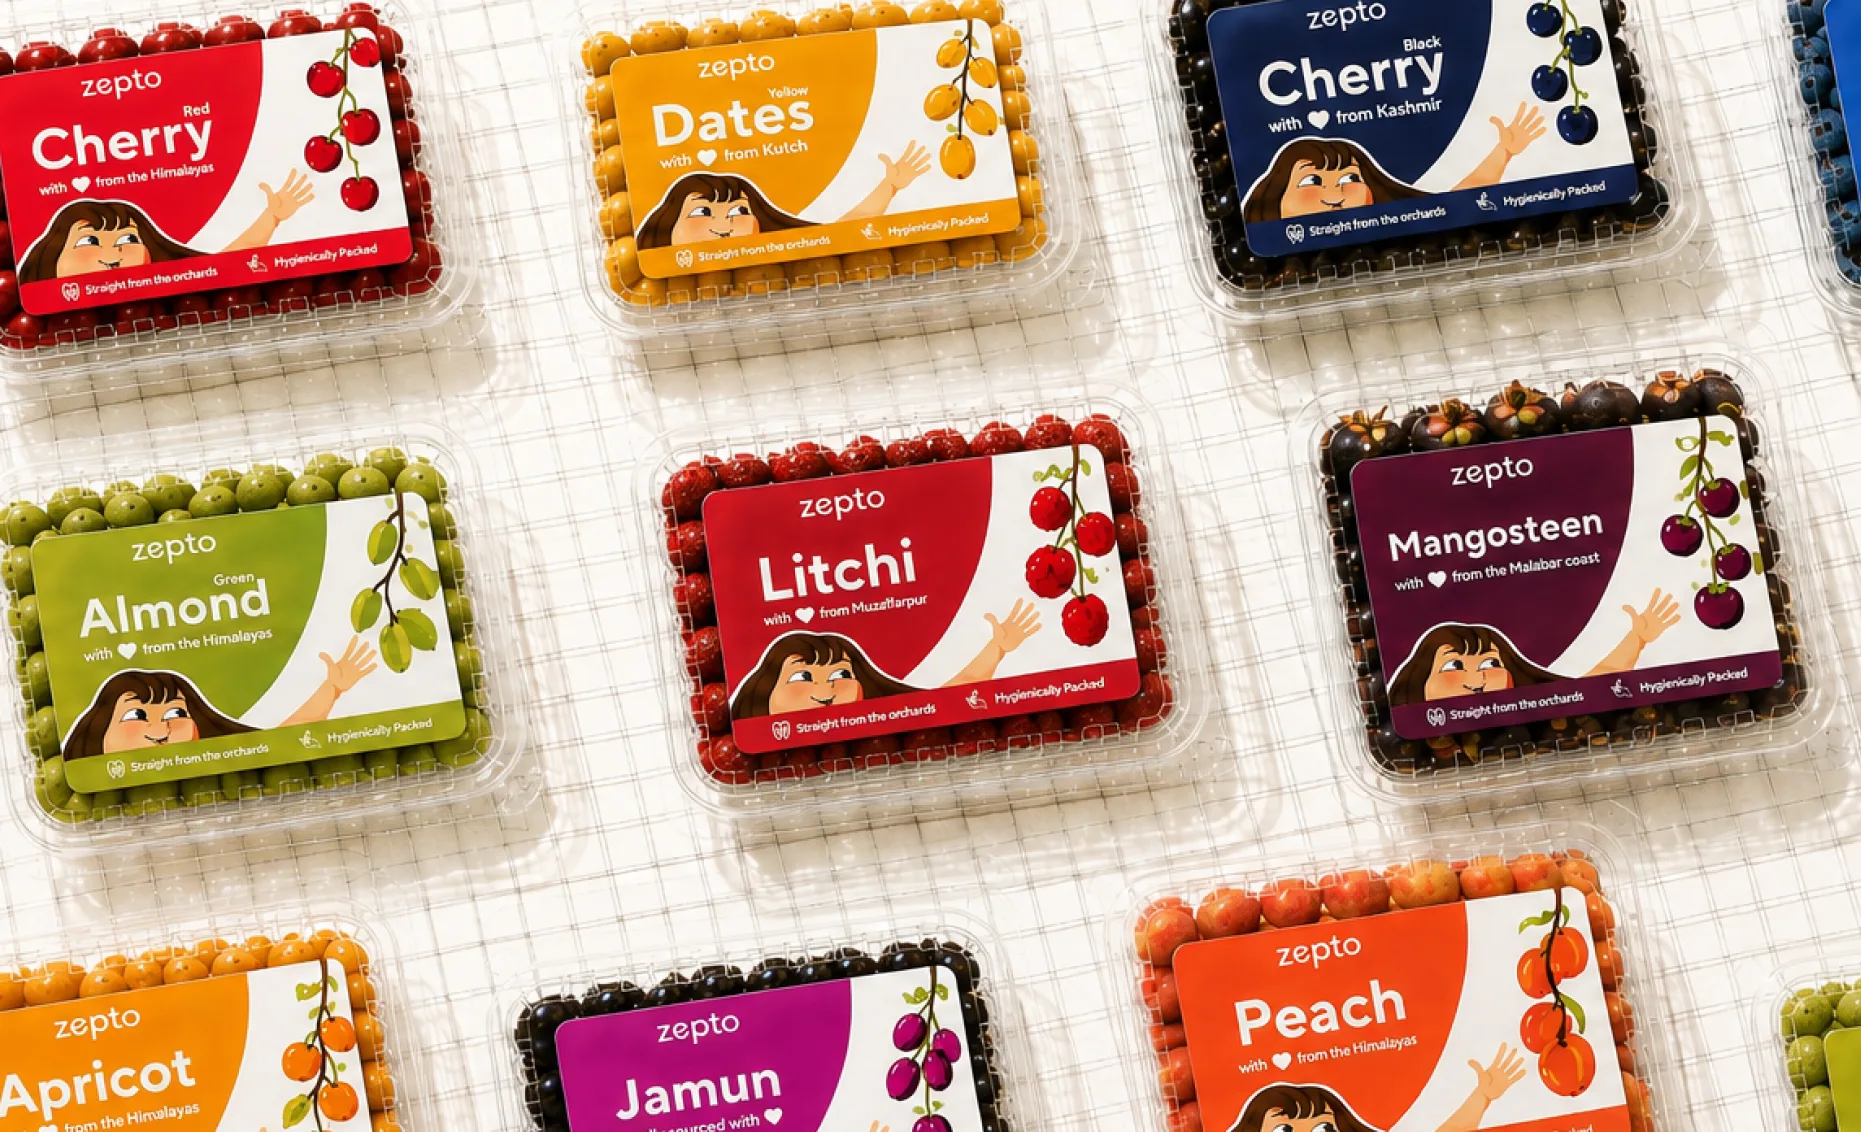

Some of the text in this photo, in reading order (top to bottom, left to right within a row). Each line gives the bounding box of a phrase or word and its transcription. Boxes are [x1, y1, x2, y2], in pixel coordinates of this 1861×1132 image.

[1306, 0, 1386, 31] zepto
[1403, 35, 1441, 51] Black
[698, 53, 775, 81] zepto
[1259, 52, 1443, 106] Cherry
[81, 69, 162, 100] zepto
[183, 102, 210, 117] Red
[652, 100, 814, 147] Dates
[1268, 97, 1442, 133] with from Kashmir
[32, 120, 212, 170] Cherry
[659, 139, 808, 168] with from Kutch
[39, 164, 214, 196] with from the Himalayas
[1503, 188, 1566, 207] Hygienically
[888, 212, 989, 237] Hygienically Packed
[1309, 206, 1446, 236] Straight from the orchards
[274, 250, 337, 268] Hygienically
[697, 249, 739, 262] Straight
[741, 246, 766, 255] from
[785, 236, 831, 250] orchards
[85, 267, 218, 295] Straight from the orchards
[1450, 456, 1533, 488] zepto
[800, 488, 885, 521] zepto
[131, 533, 216, 564] zepto
[1388, 514, 1603, 561] Mangosteen
[213, 573, 254, 586] Green
[759, 537, 916, 602] Litchi
[1395, 552, 1600, 591] with from the Malabar coast
[80, 578, 270, 638] Almond
[764, 612, 792, 626] with
[819, 606, 849, 618] from
[83, 629, 273, 662] with from the Himalayas
[994, 684, 1062, 704] Hygienically
[1640, 674, 1706, 693] Hygienically
[796, 703, 936, 733] Straight from the orchards
[1450, 691, 1584, 720] Straight from the orchards
[327, 725, 392, 744] Hygienically
[130, 744, 269, 772] Straight from the orchards
[1276, 935, 1361, 969] zepto
[54, 1007, 140, 1040] zepto
[1234, 979, 1406, 1046] Peach
[657, 1013, 740, 1044] zepto
[1239, 1035, 1417, 1073] with from the Himalayas
[0, 1050, 197, 1121] Apricot
[616, 1070, 782, 1120] Jamun
[100, 1115, 124, 1129] the
[127, 1103, 200, 1125] Himalayas
[728, 1114, 760, 1129] with
